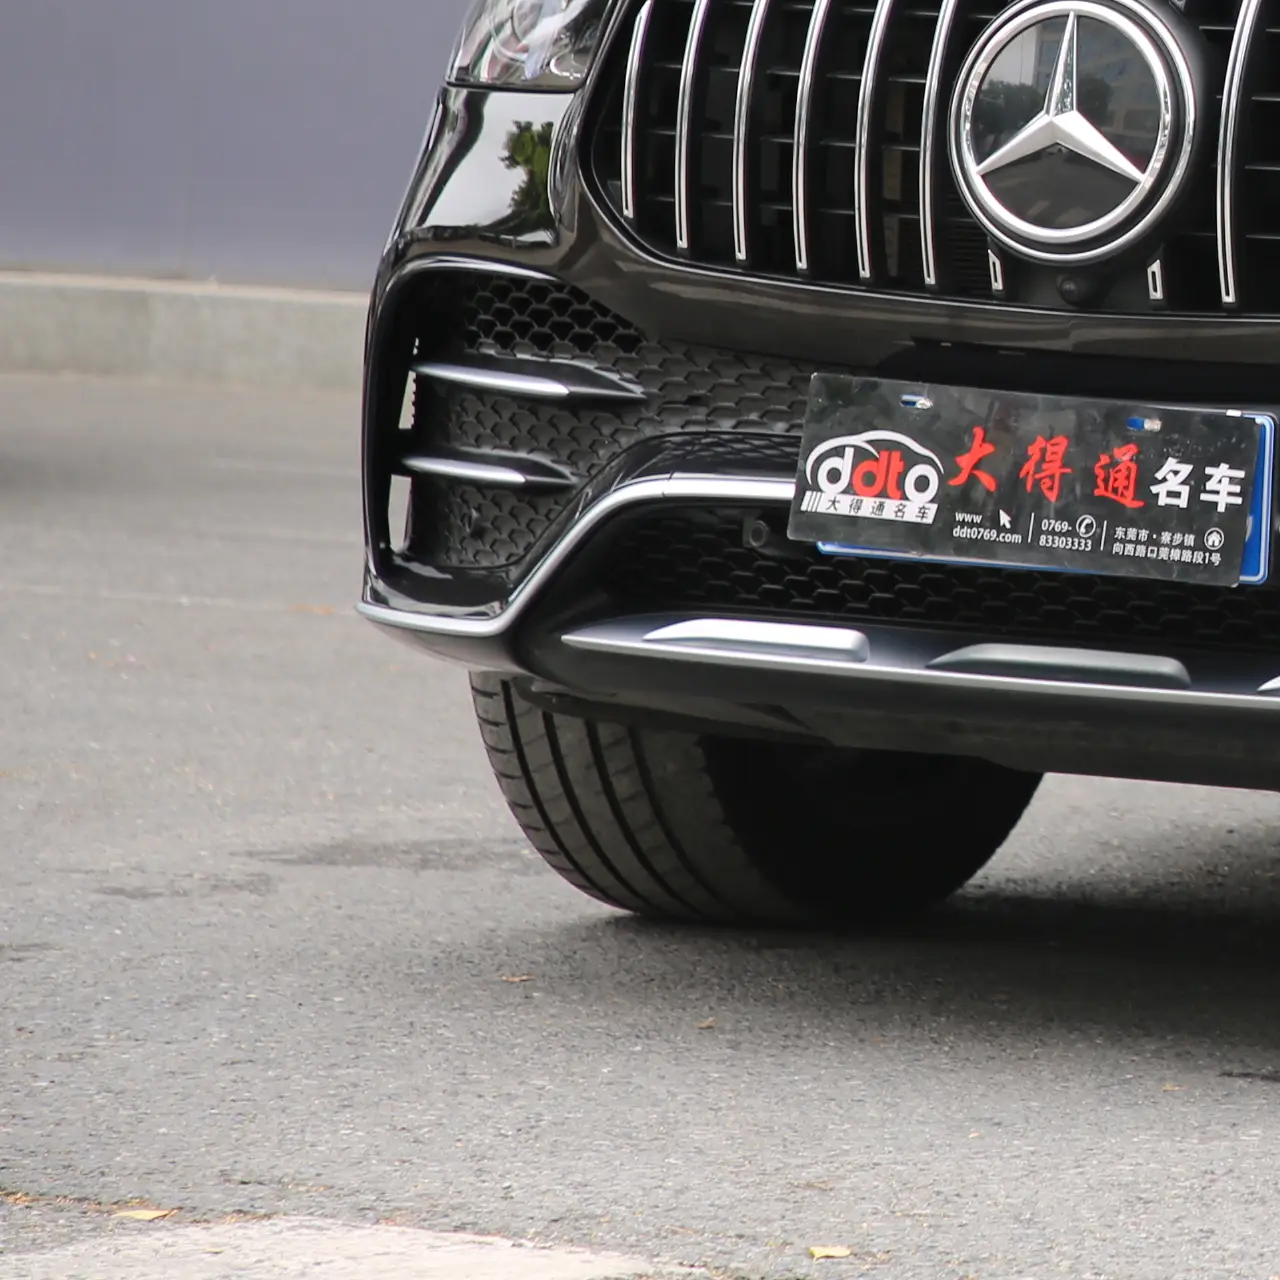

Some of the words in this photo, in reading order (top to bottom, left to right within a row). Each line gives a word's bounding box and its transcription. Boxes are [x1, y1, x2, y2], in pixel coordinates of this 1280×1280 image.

[825, 496, 931, 521] 大得通名车
[955, 512, 983, 524] www
[952, 525, 1022, 544] ddt0769.com
[1039, 534, 1092, 552] 83303333
